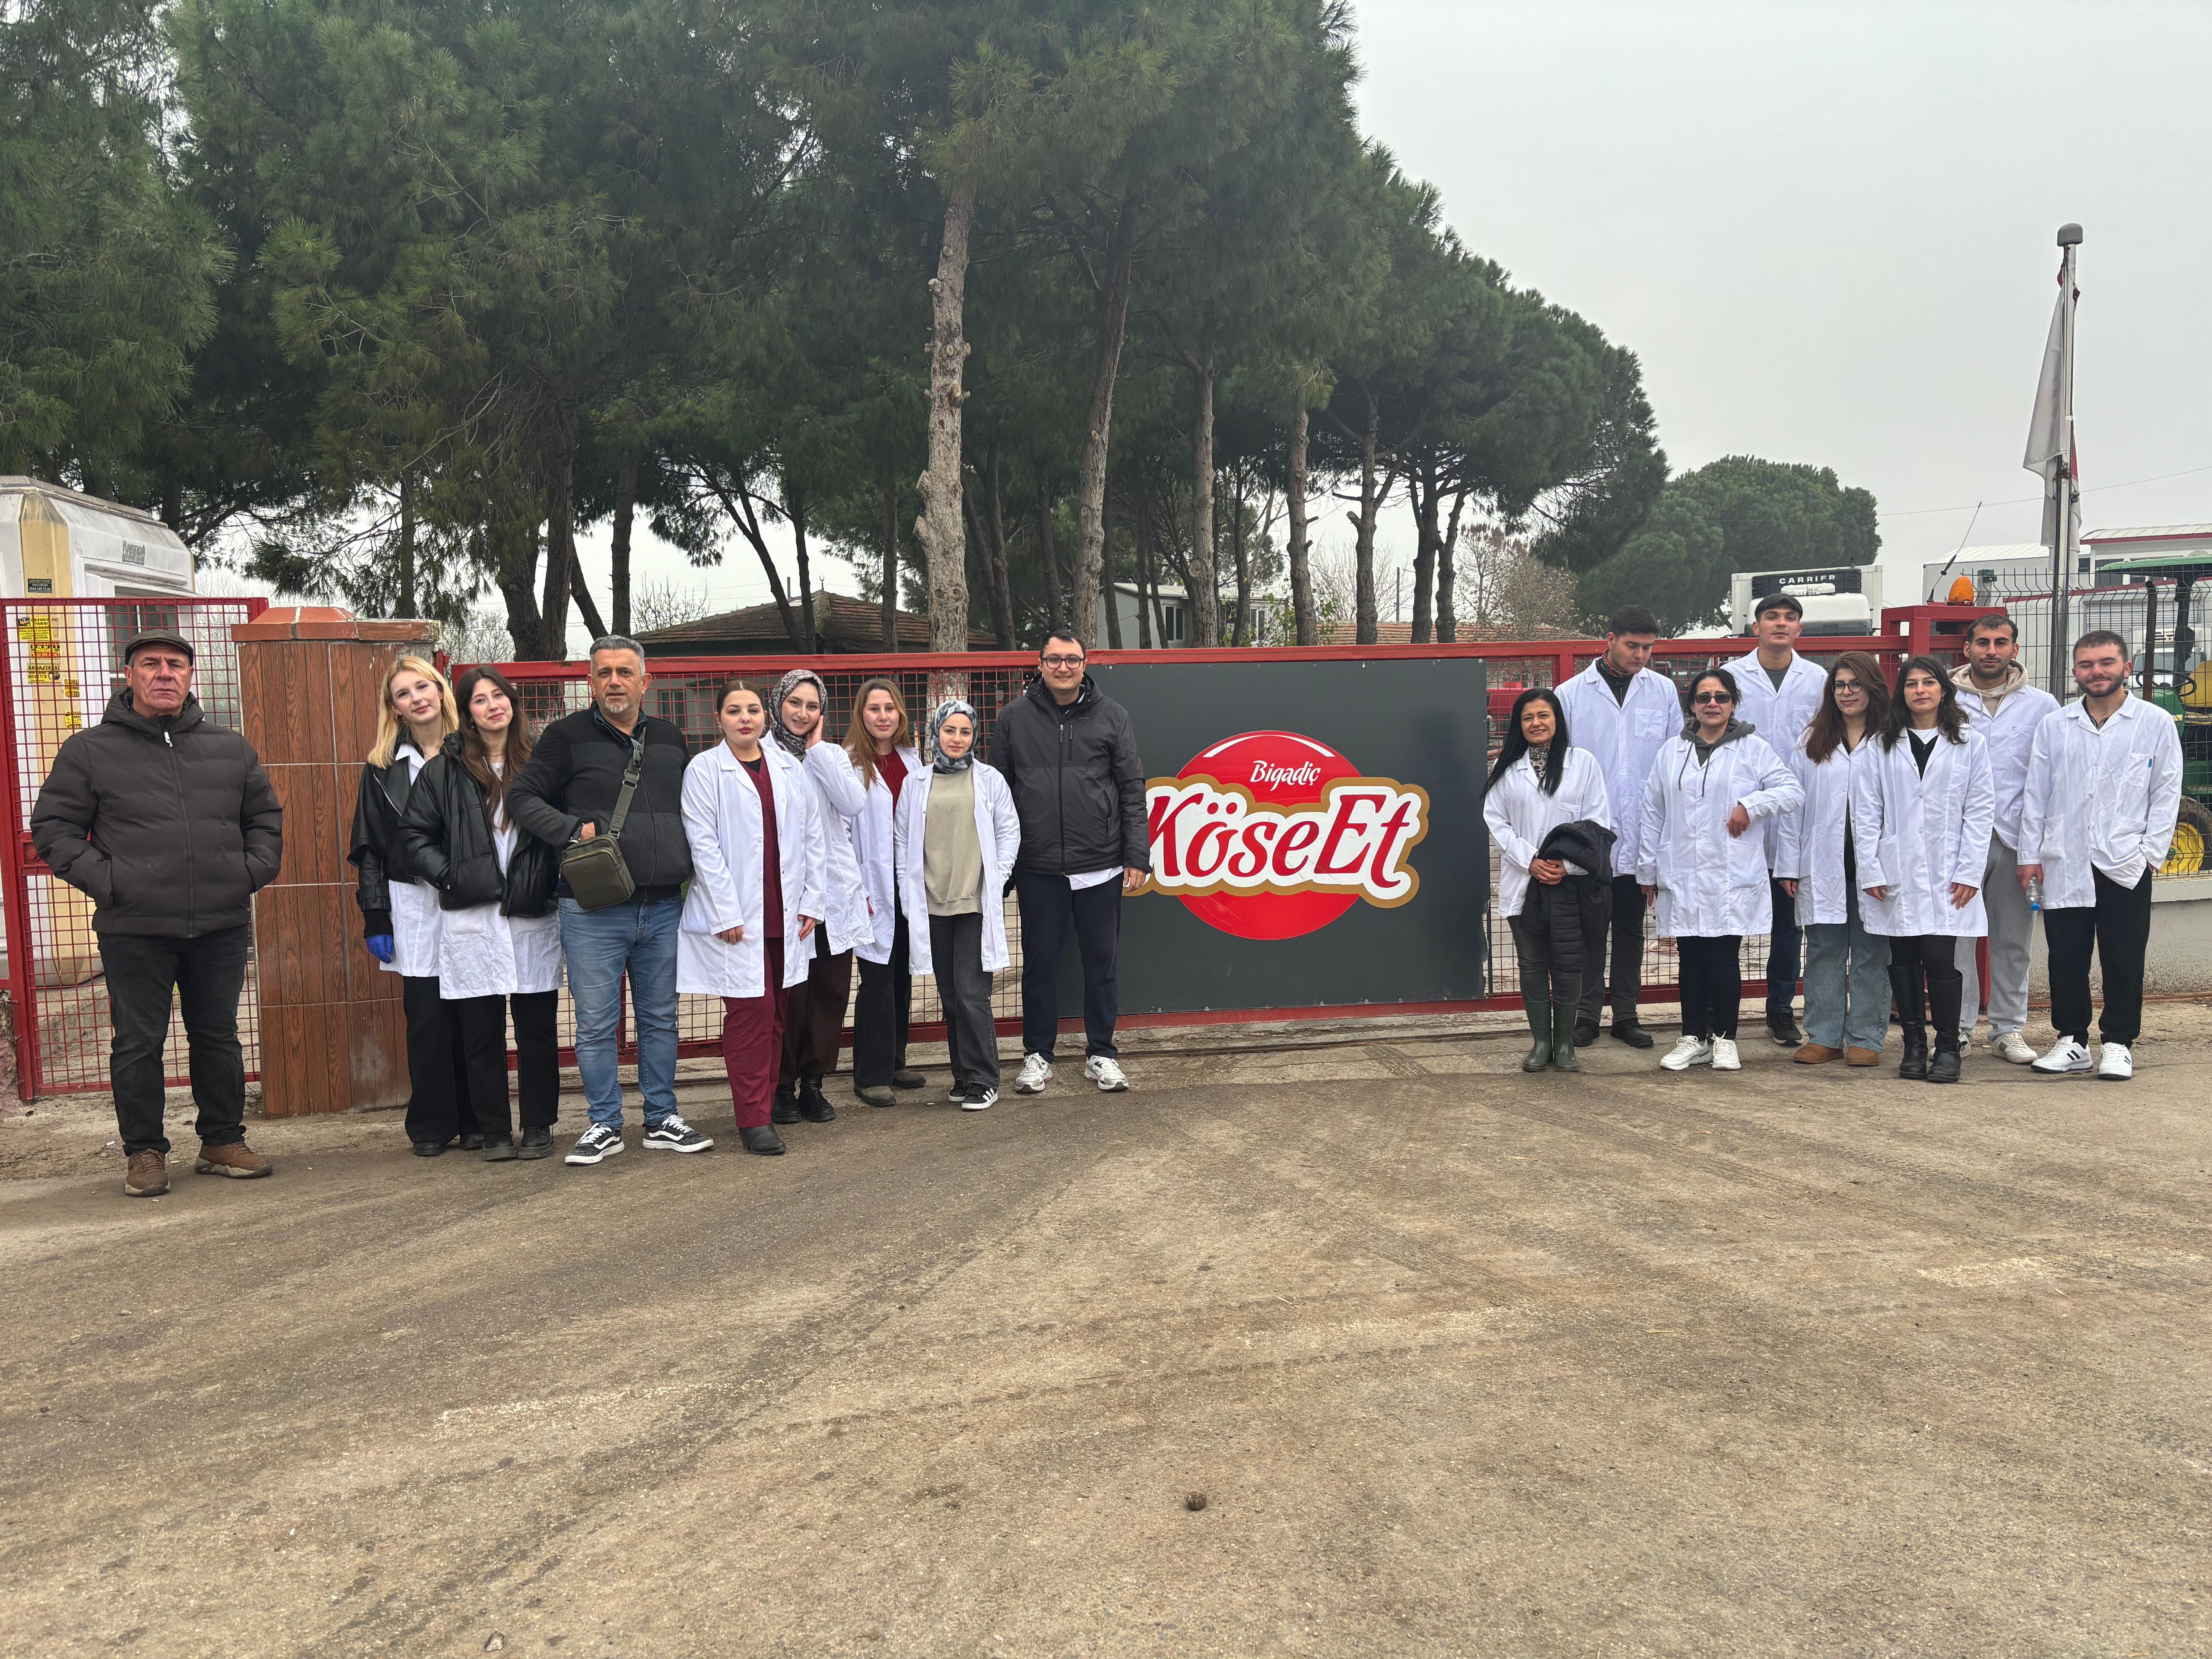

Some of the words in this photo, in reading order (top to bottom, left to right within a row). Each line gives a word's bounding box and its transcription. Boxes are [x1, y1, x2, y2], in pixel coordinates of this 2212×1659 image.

[1779, 575, 1836, 584] CARRIER
[1250, 760, 1321, 791] Bigadiç
[1149, 793, 1410, 888] KöseEt
